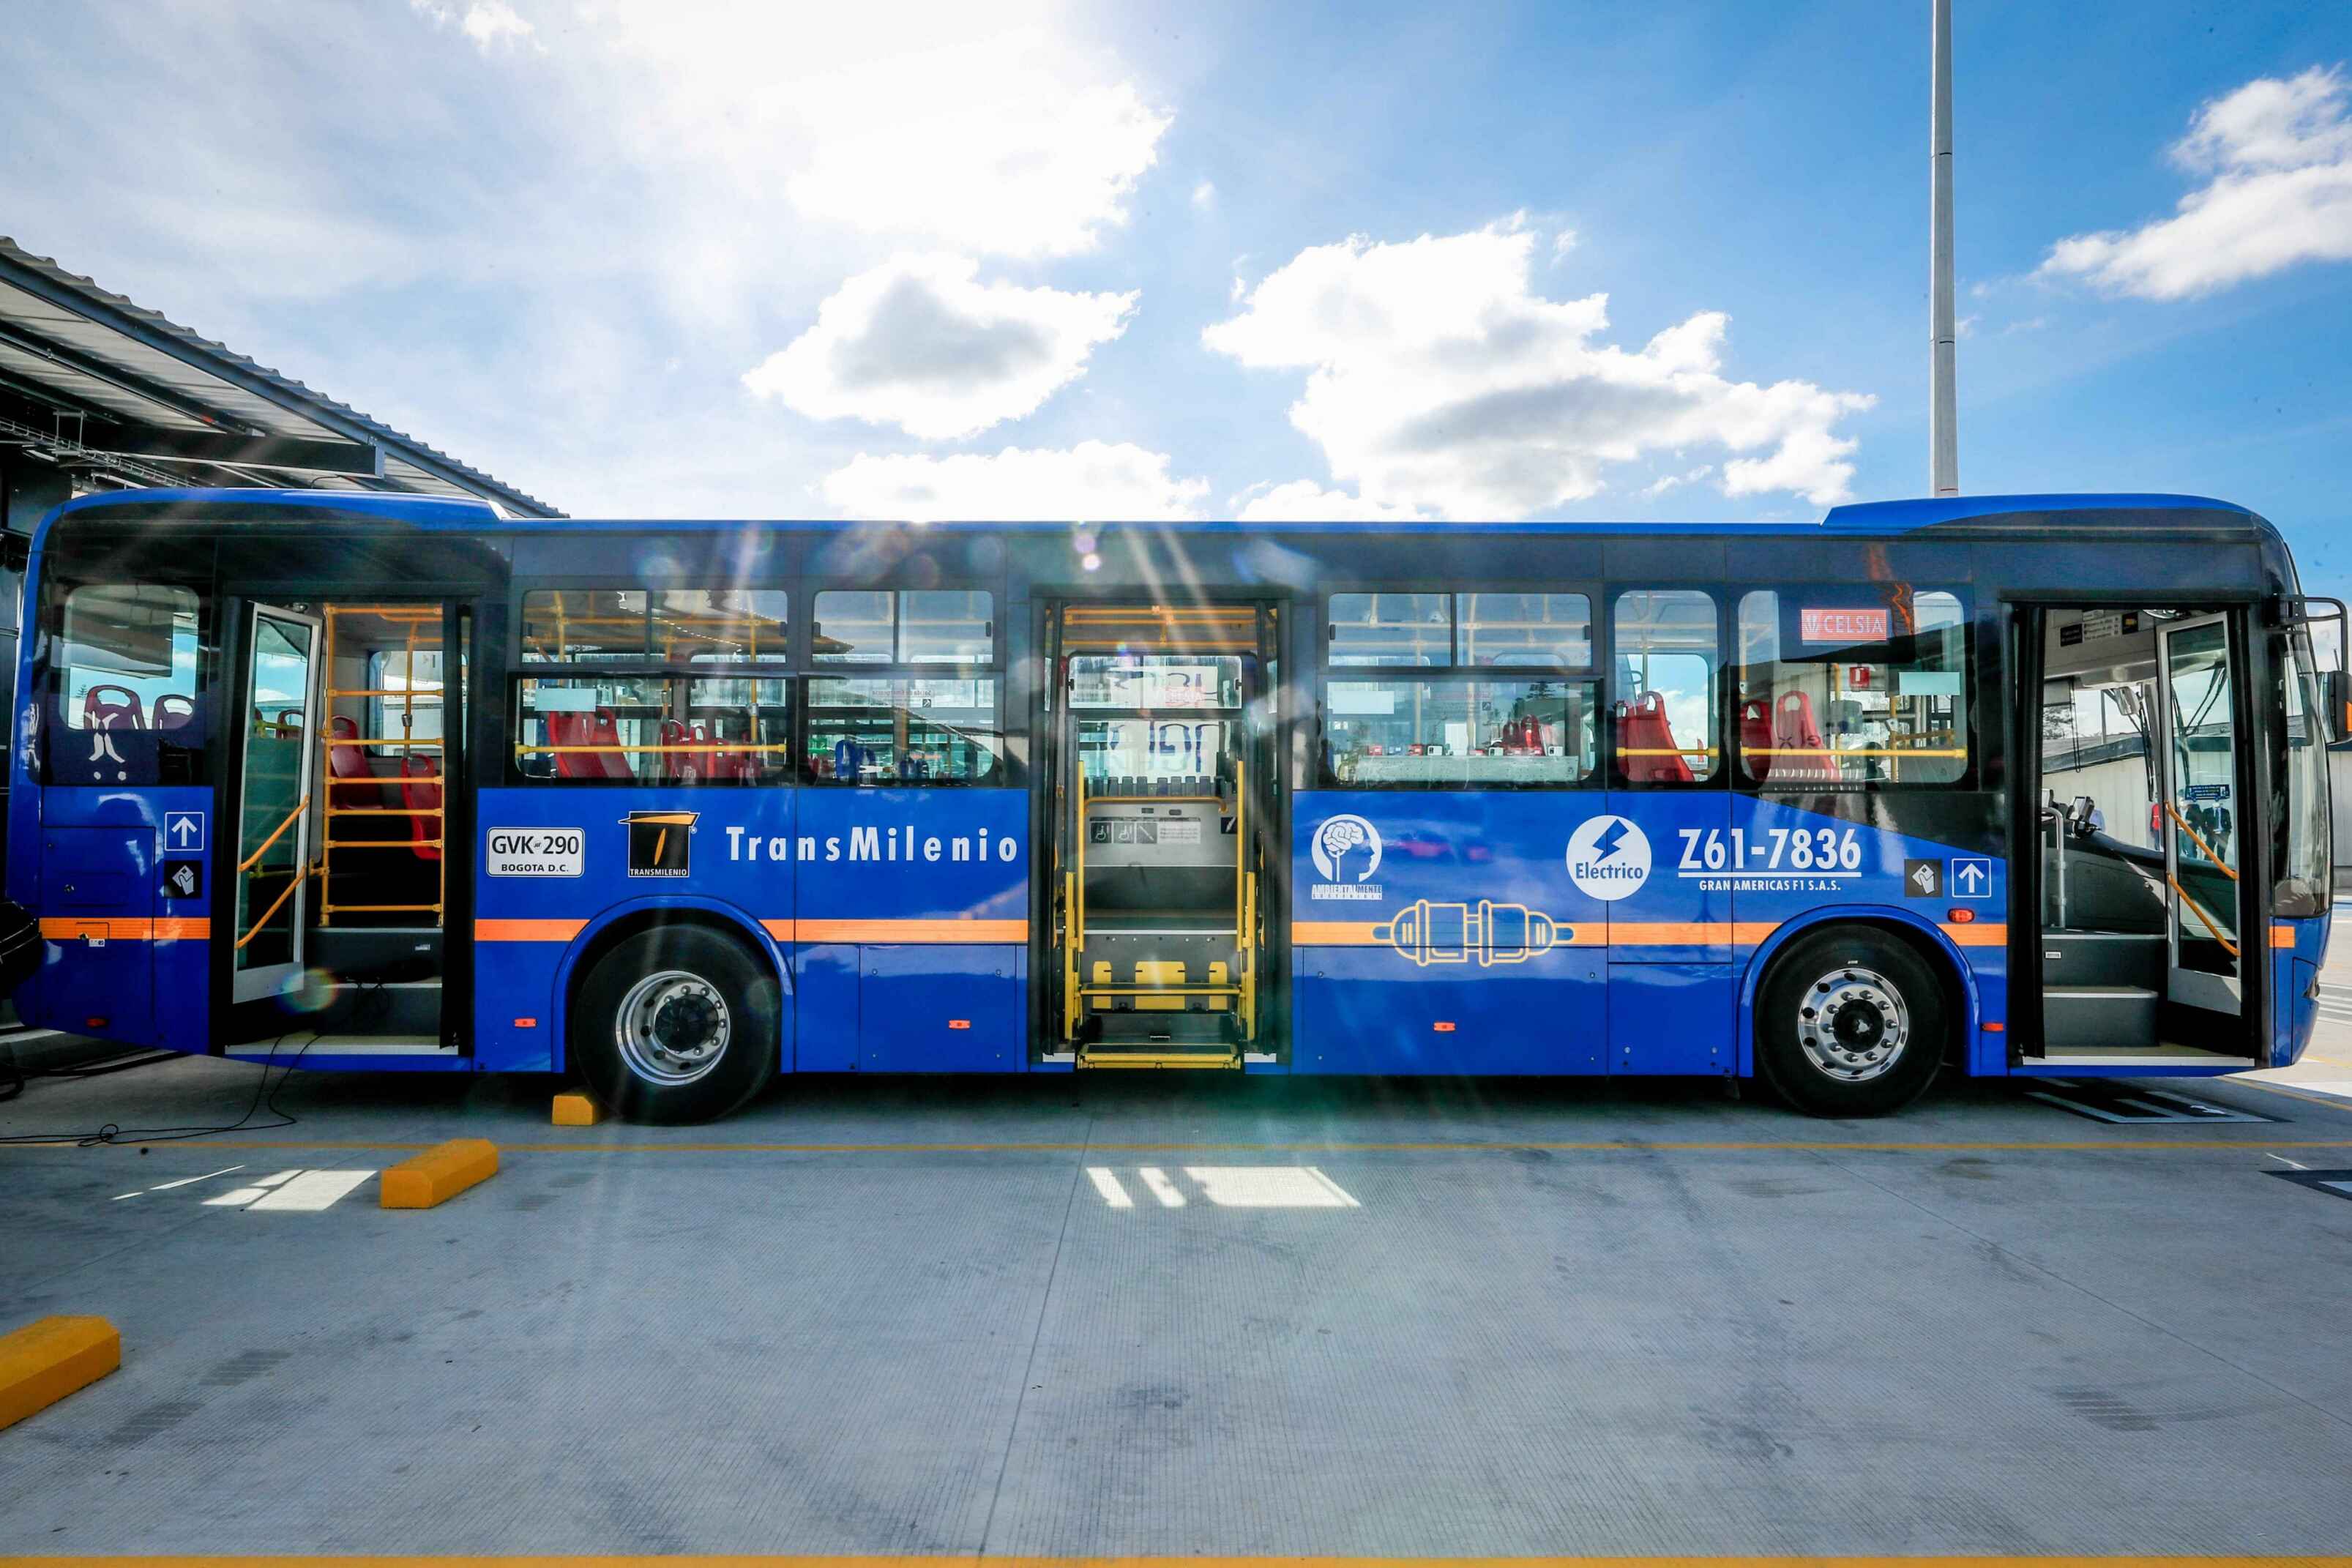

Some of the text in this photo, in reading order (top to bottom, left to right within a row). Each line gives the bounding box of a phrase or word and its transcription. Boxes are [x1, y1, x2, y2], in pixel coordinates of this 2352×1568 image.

[1824, 616, 1884, 632] CELSIA
[726, 826, 1017, 862] TransMilenio
[1679, 829, 1862, 869] Z61-7836
[1699, 880, 1841, 891] GRAN AMERICAS F1 S.A.S.
